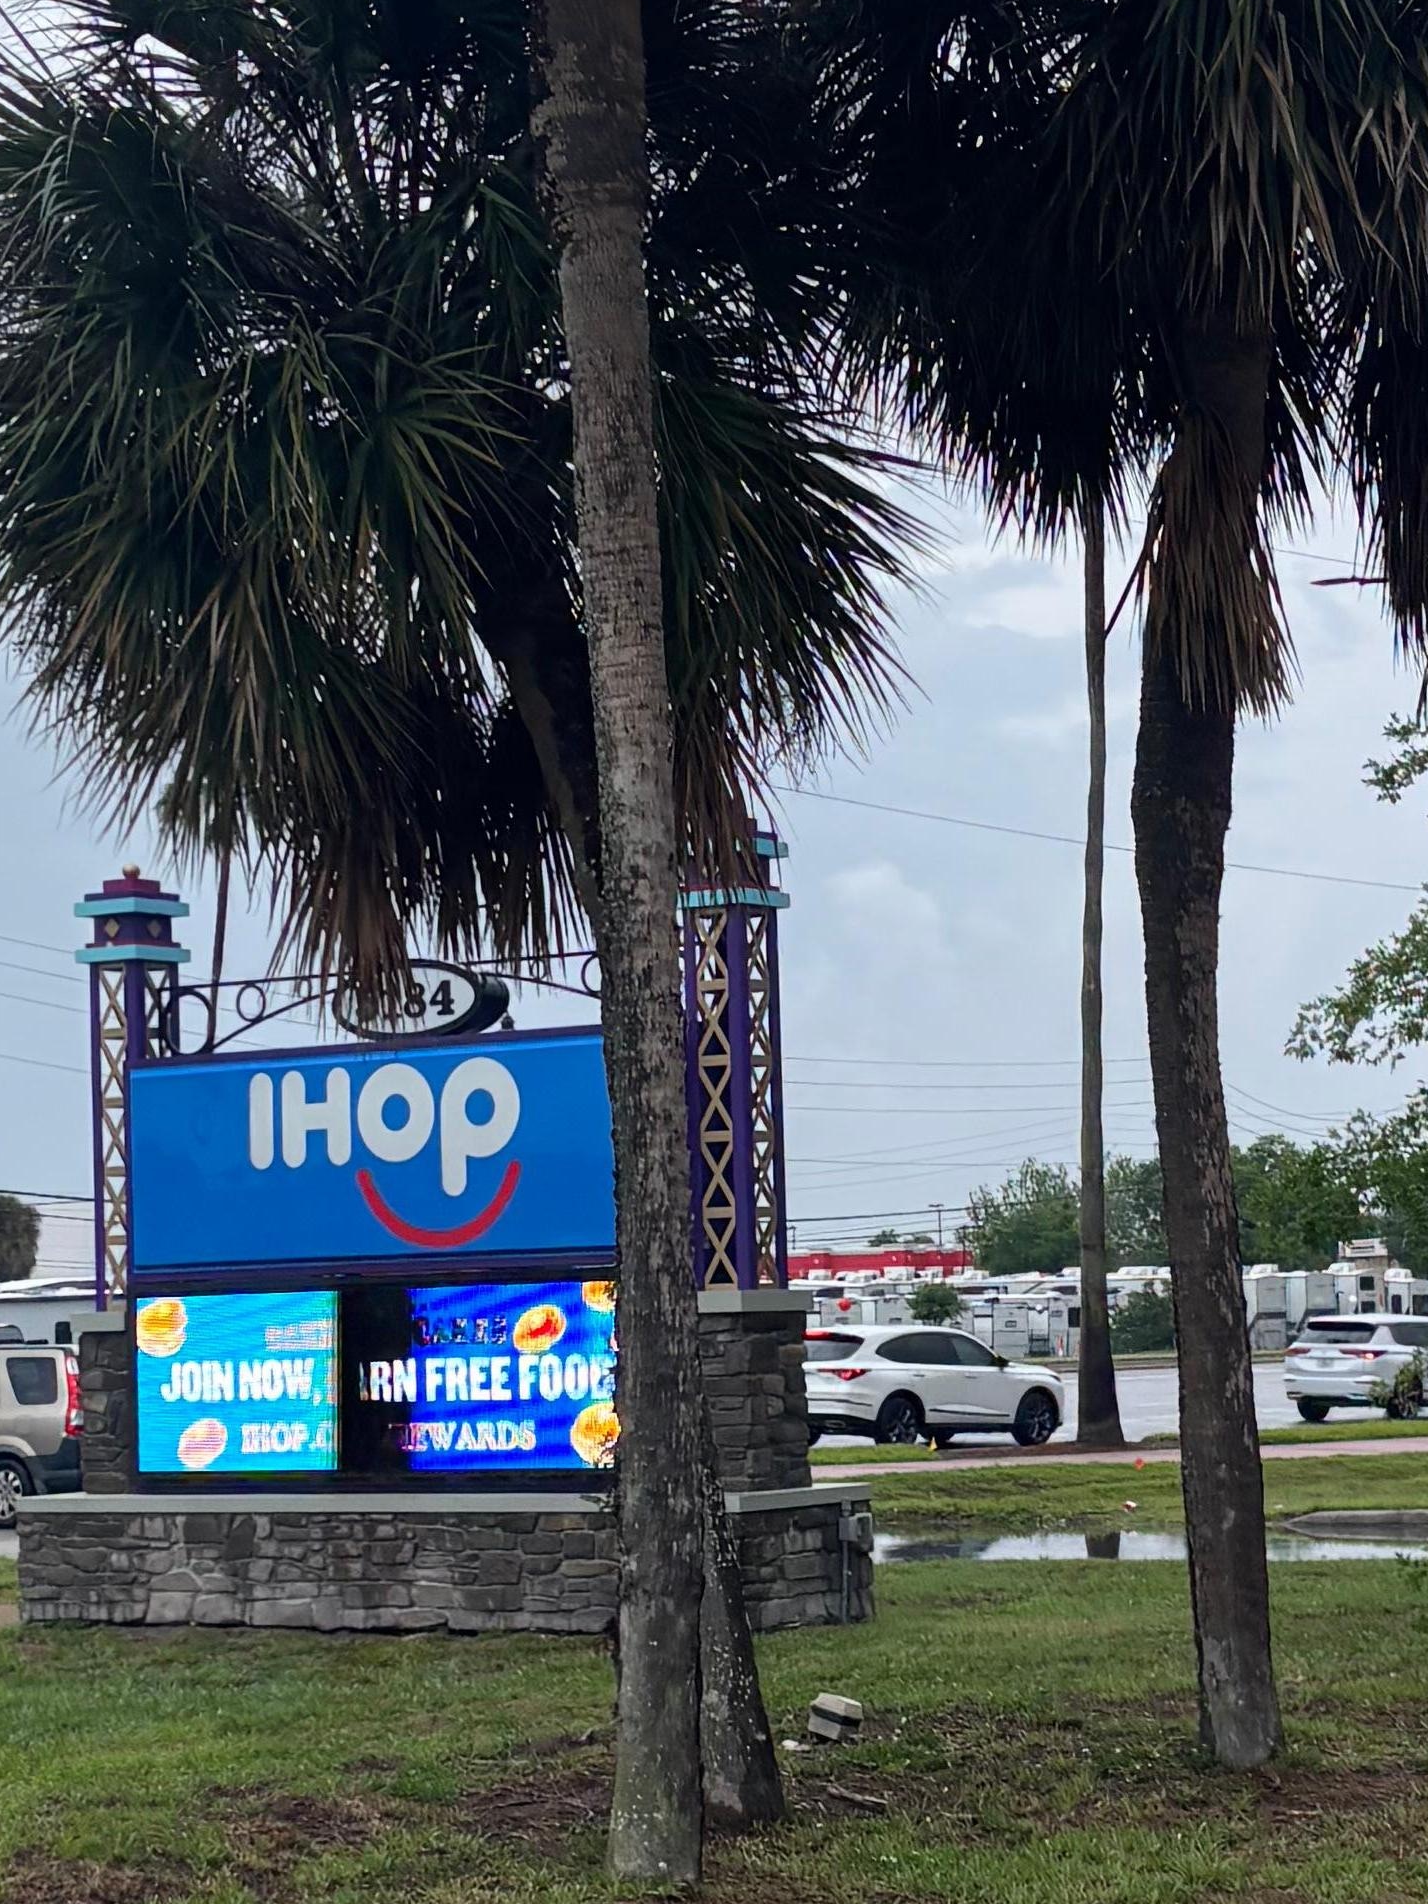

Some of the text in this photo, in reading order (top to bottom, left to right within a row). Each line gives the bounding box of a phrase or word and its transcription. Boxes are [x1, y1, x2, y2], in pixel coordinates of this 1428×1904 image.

[160, 1360, 235, 1403] JOIN
[238, 1357, 321, 1407] NOW,
[425, 1355, 512, 1401] FREE
